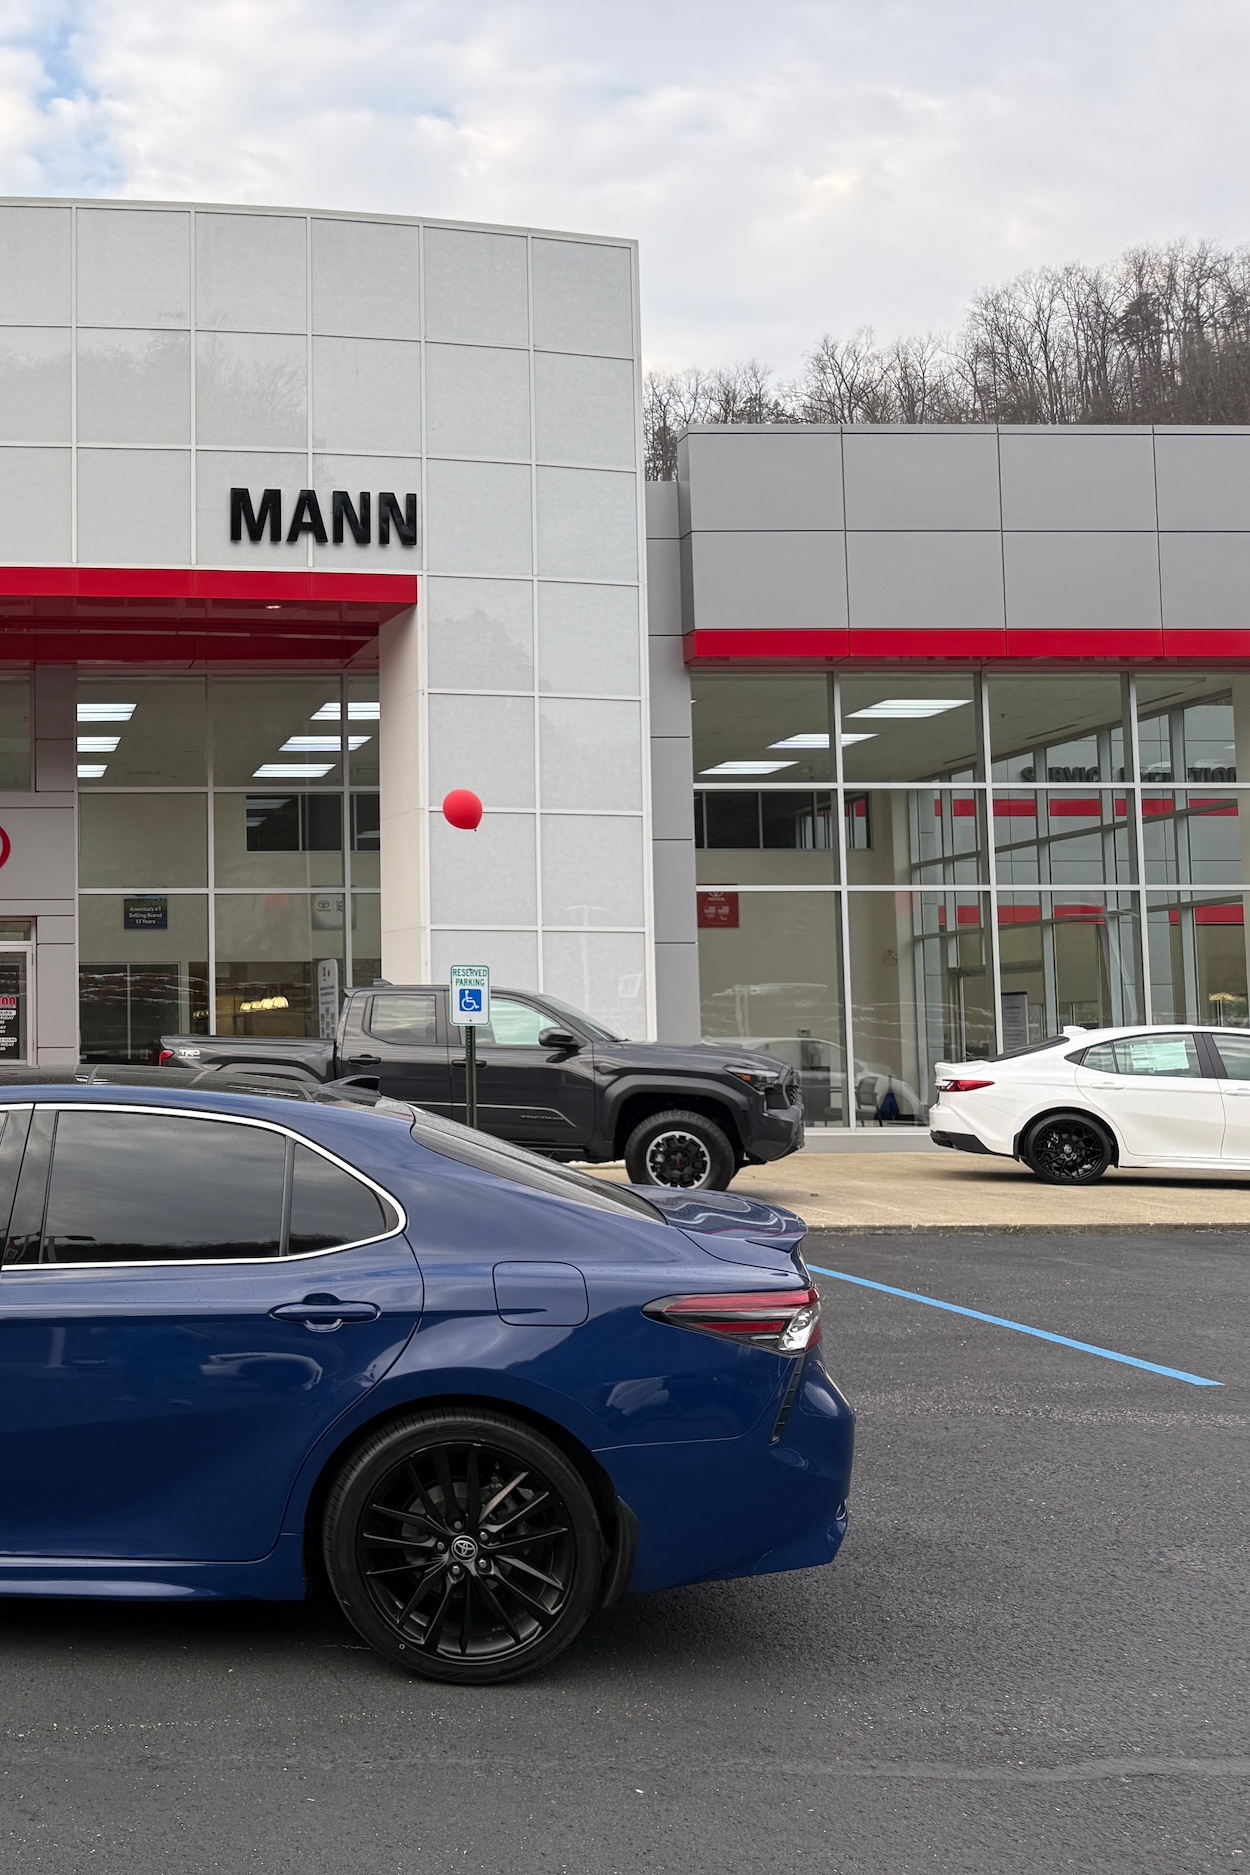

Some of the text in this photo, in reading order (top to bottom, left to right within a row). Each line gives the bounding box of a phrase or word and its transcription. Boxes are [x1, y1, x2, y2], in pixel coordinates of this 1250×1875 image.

[230, 487, 417, 545] MANN
[452, 968, 488, 977] RESERVED
[455, 978, 485, 987] PARKING
